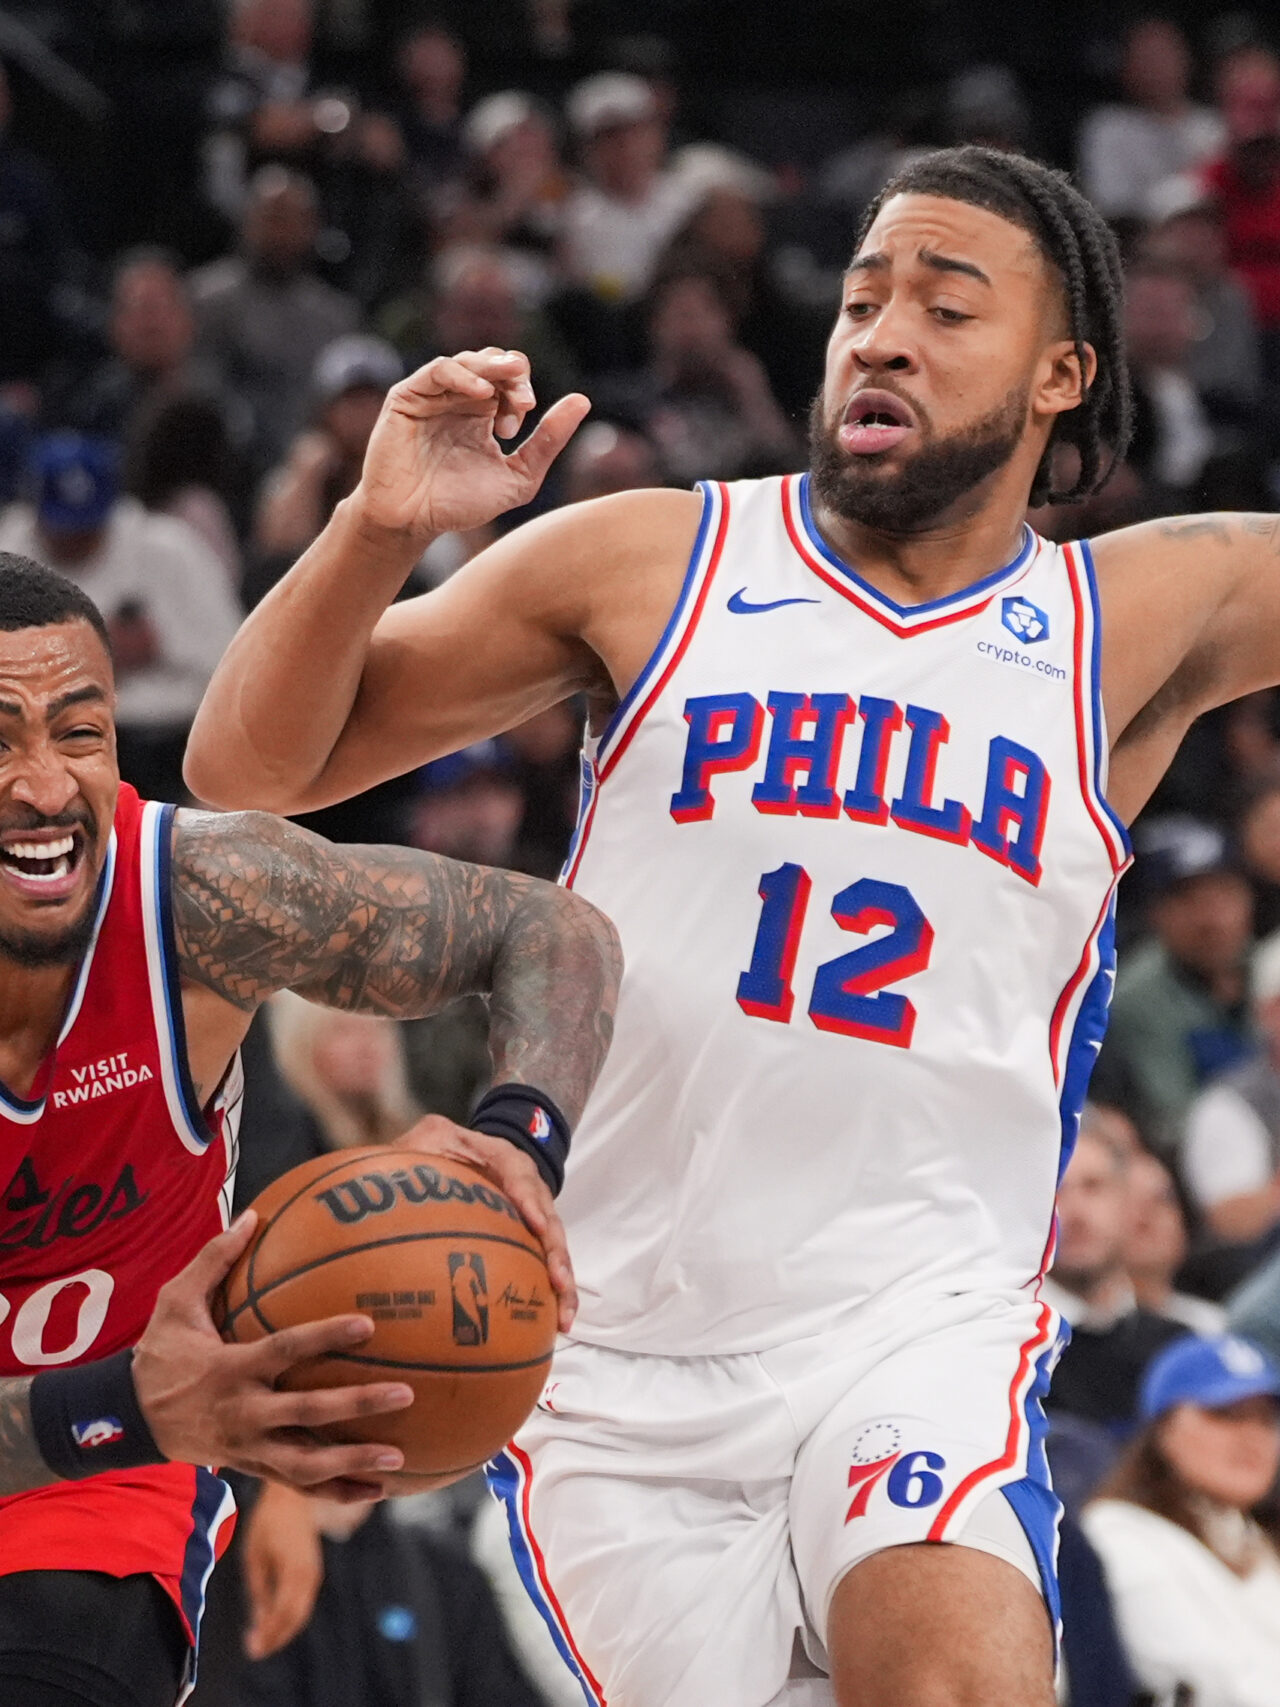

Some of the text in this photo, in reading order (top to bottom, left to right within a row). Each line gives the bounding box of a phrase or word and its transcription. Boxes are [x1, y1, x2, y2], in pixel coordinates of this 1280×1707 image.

[977, 641, 1066, 680] crypto.com
[670, 690, 1051, 888] PHILA
[735, 861, 935, 1049] 12
[53, 1064, 154, 1109] RWANDA
[71, 1052, 128, 1084] VISIT
[844, 1449, 946, 1527] 76
